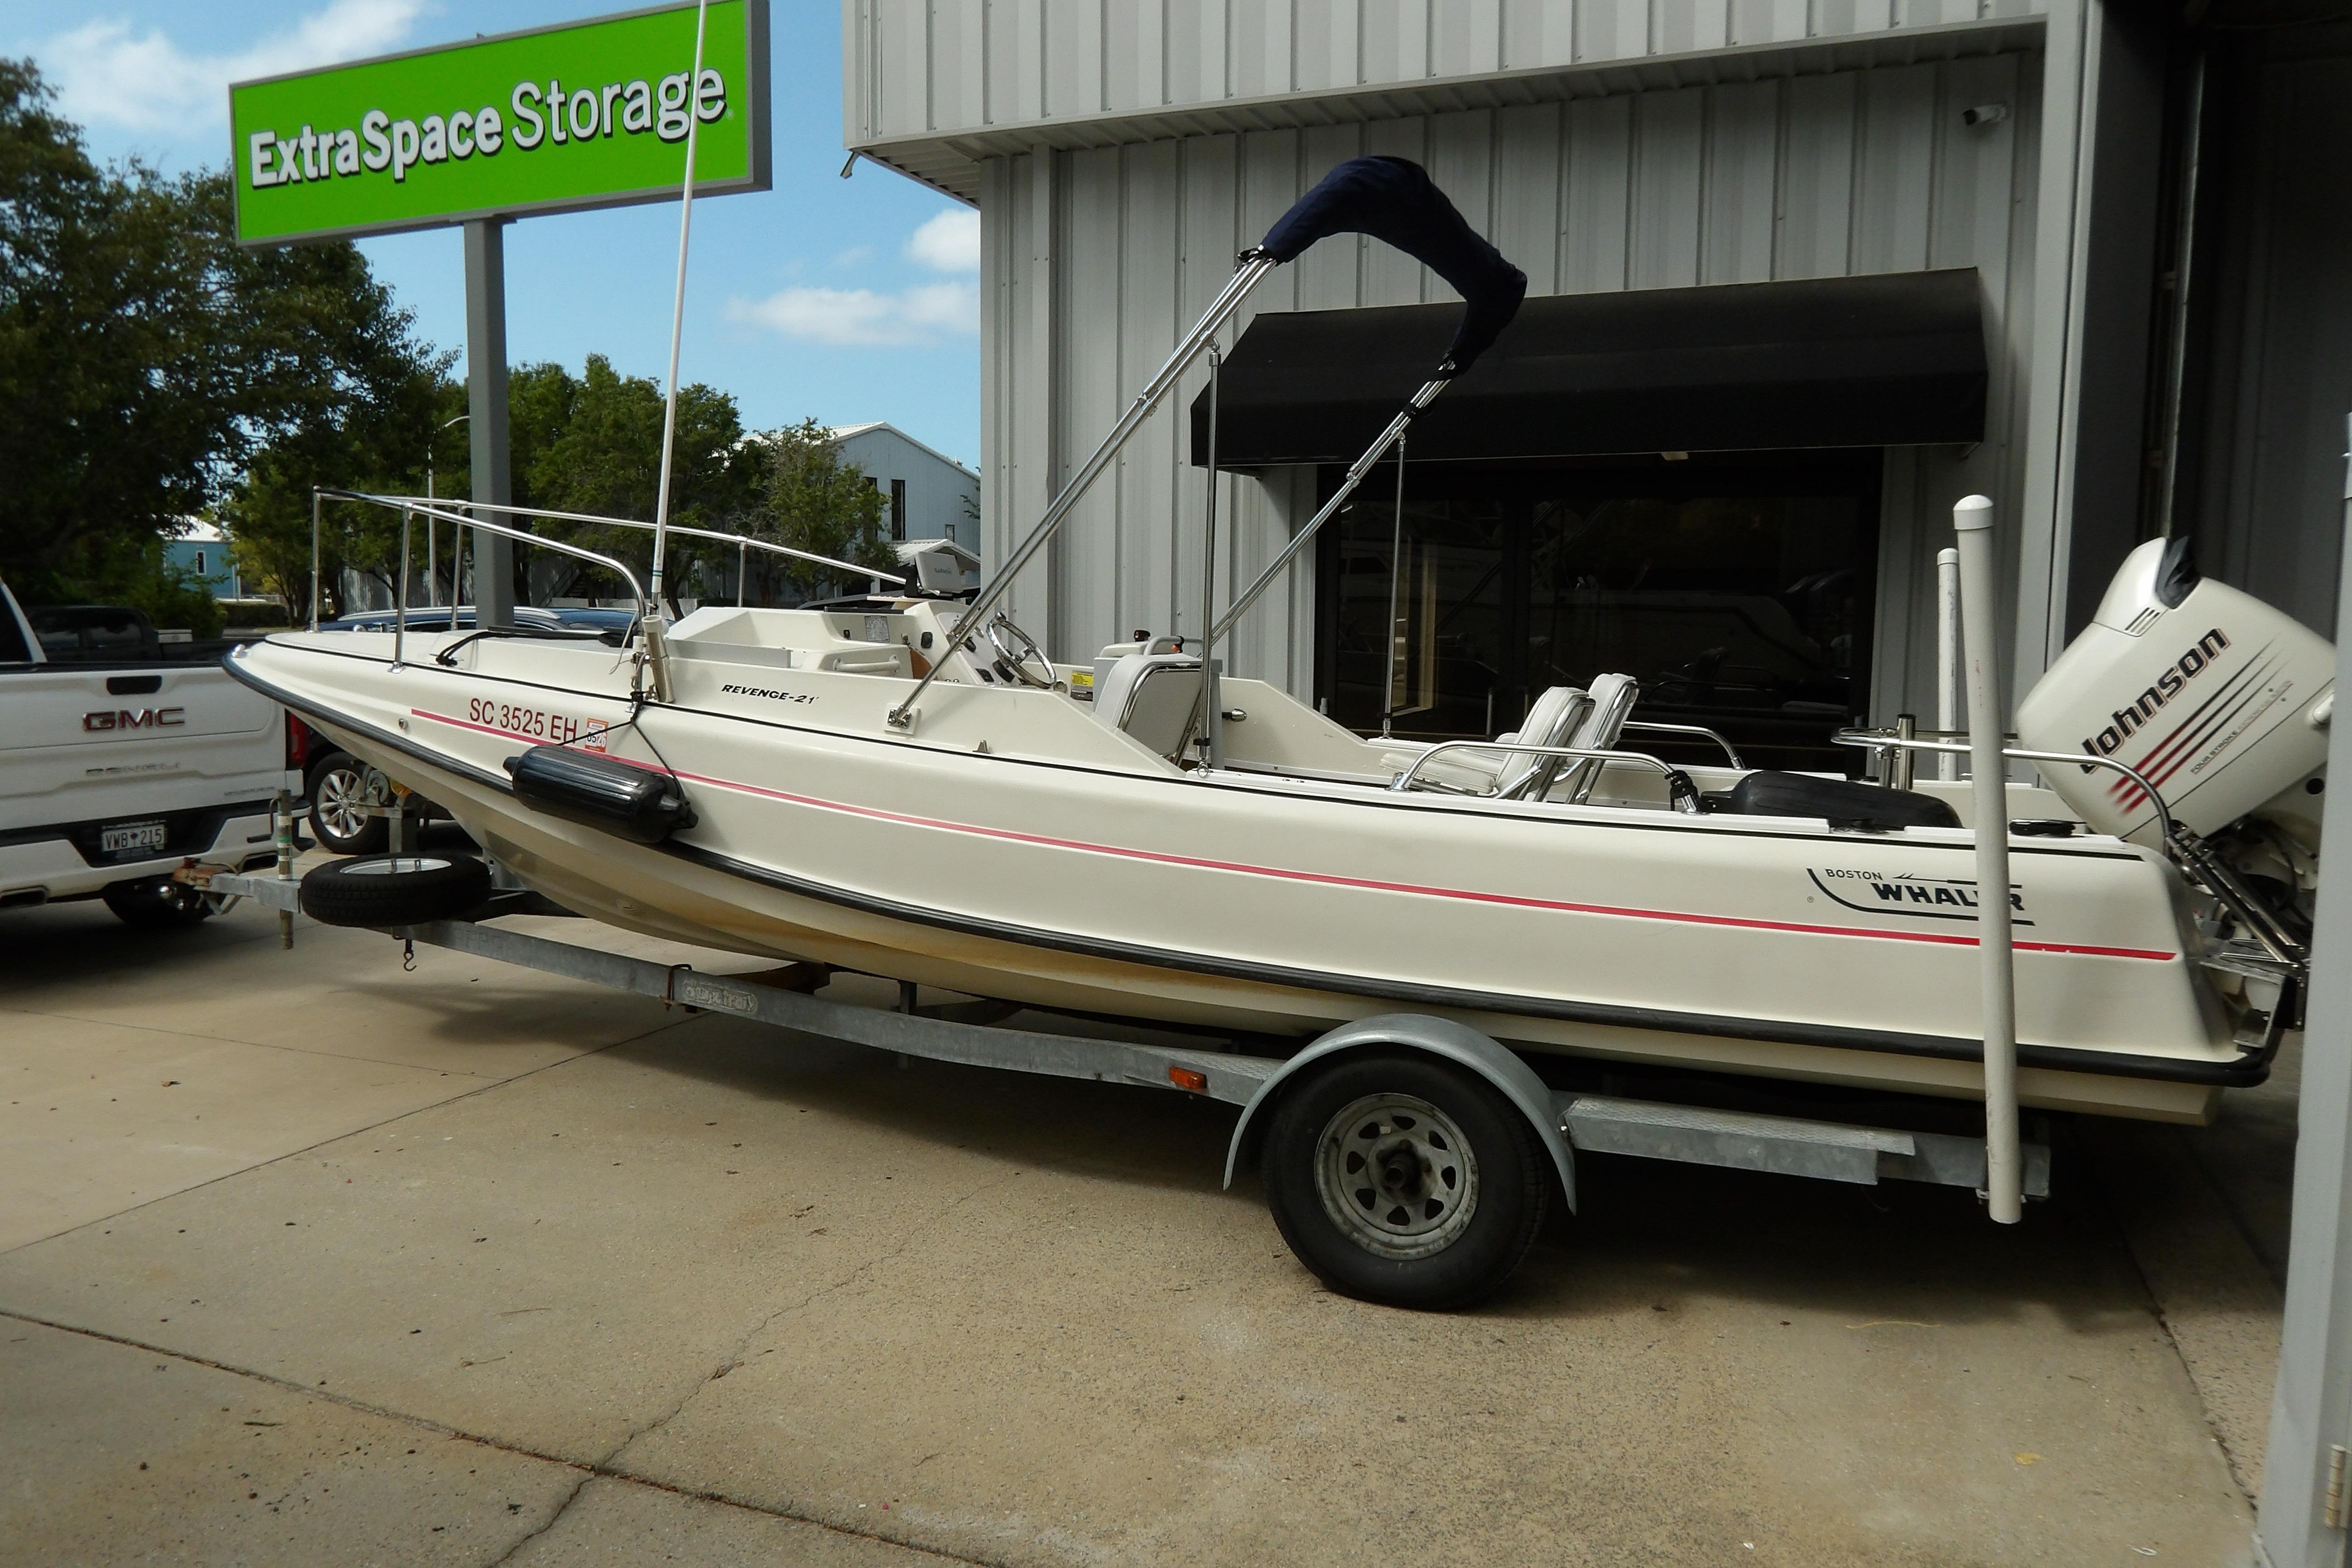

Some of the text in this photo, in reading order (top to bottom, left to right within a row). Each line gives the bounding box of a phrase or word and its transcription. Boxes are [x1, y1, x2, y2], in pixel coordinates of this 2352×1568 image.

[250, 67, 727, 187] ExtraSpace Storage
[83, 707, 185, 730] GMC
[2080, 628, 2231, 775] Johnson
[470, 697, 577, 744] SC 3525 EH
[2190, 730, 2238, 774] FOUR STROKE
[105, 828, 162, 849] VWB 215
[1825, 869, 1883, 881] BOSTON
[1870, 882, 2025, 911] WHALR
